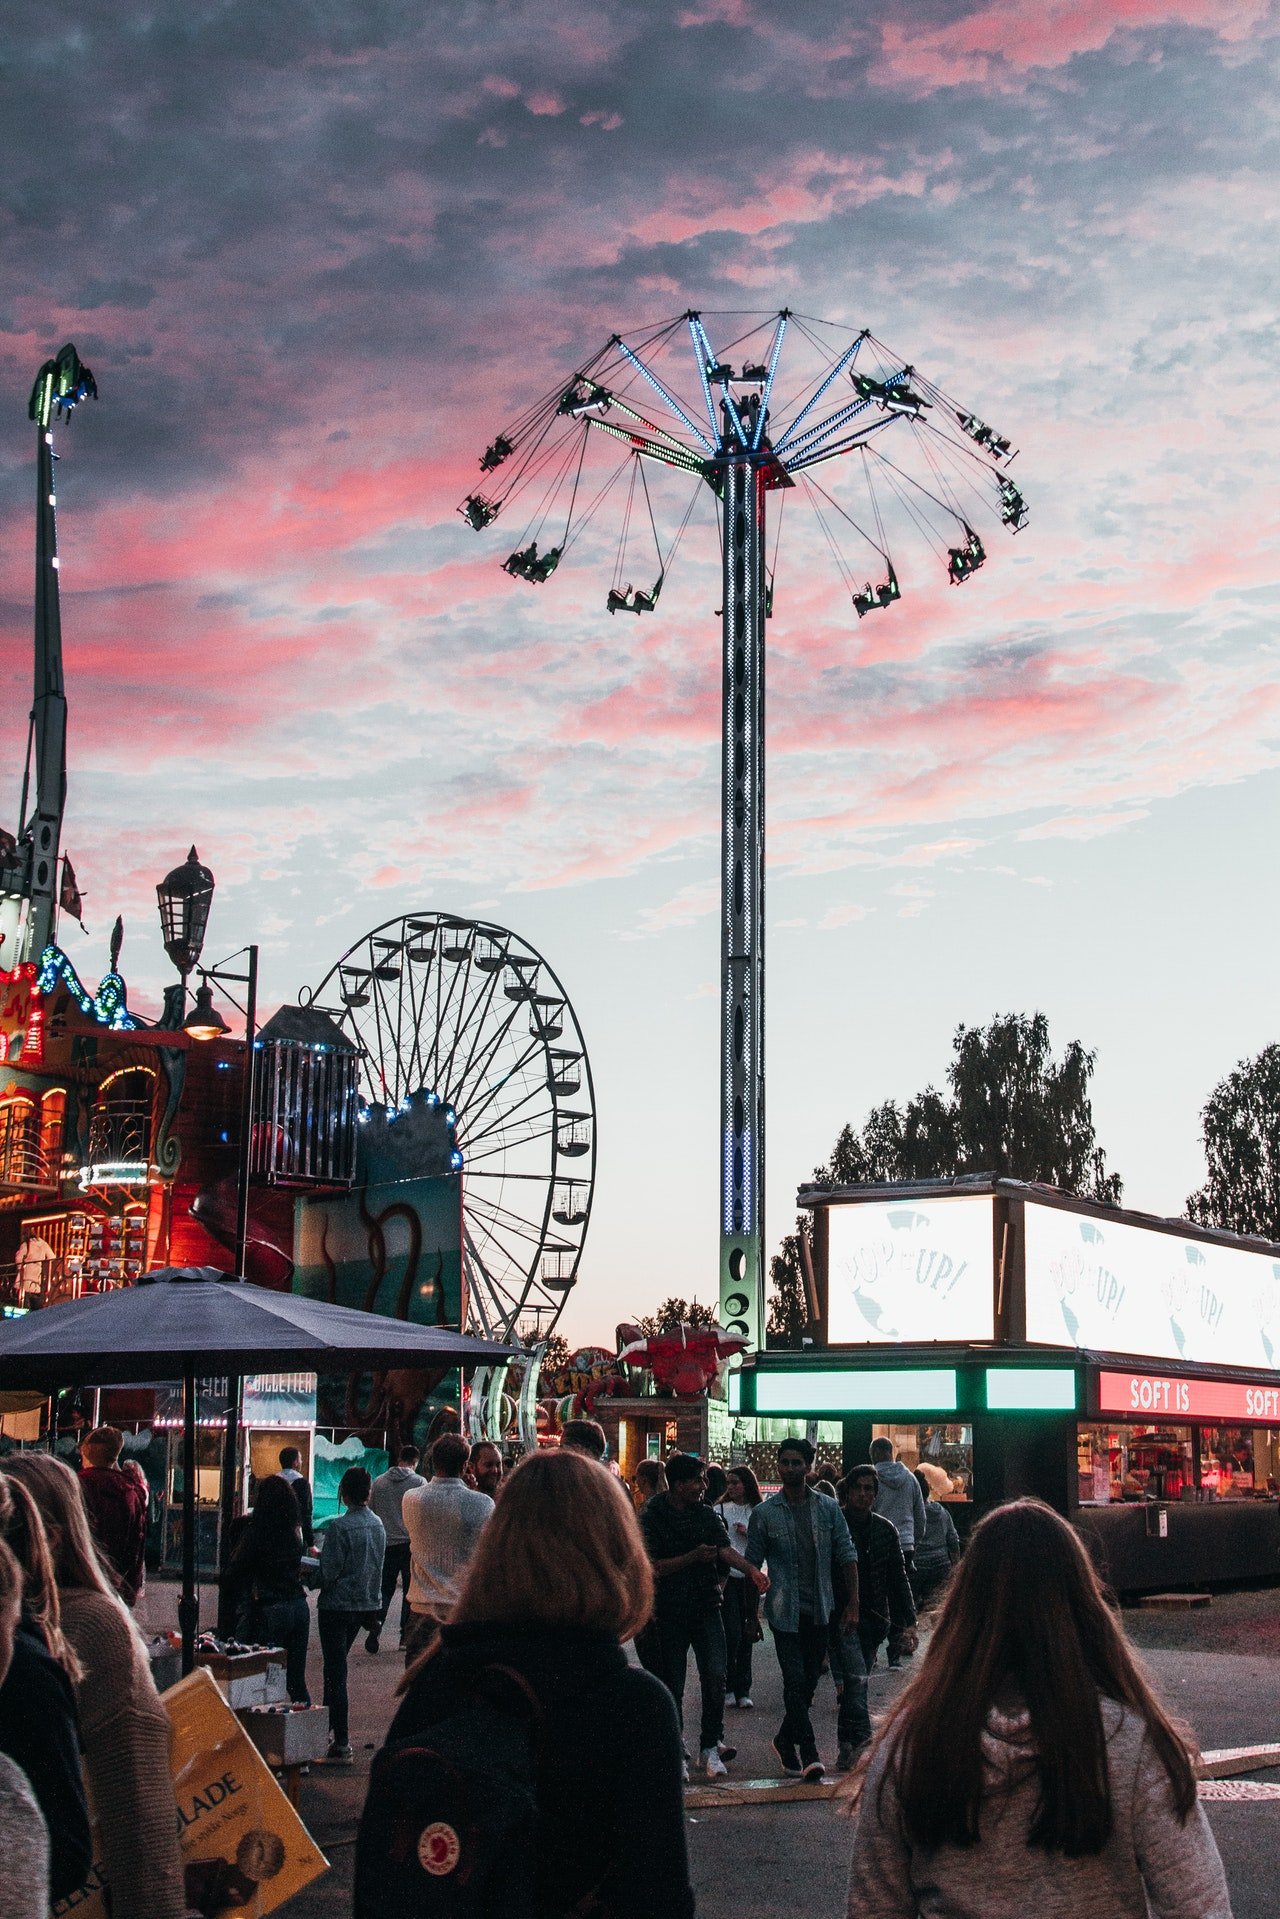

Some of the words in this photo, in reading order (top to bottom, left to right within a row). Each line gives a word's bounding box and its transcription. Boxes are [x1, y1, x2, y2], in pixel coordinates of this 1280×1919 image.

[916, 1248, 968, 1300] UP!
[1097, 1266, 1126, 1321] UP!
[1130, 1378, 1171, 1410] SOFT
[1176, 1383, 1190, 1412] IS
[1246, 1388, 1279, 1417] SOFT
